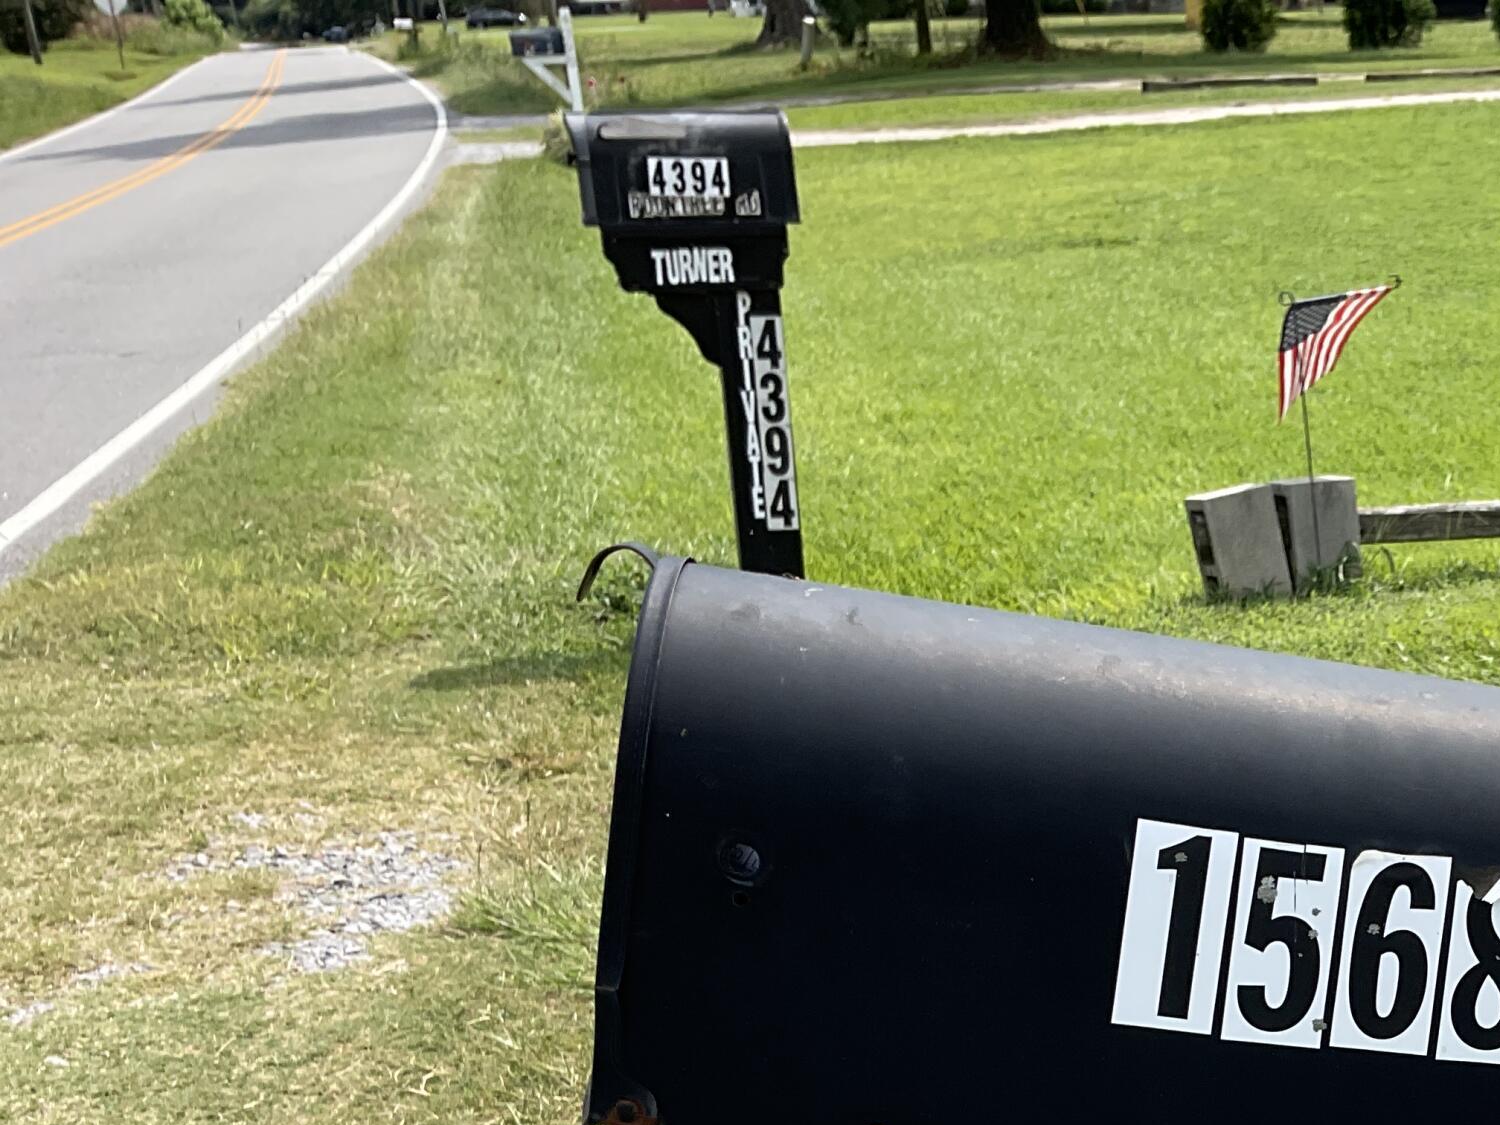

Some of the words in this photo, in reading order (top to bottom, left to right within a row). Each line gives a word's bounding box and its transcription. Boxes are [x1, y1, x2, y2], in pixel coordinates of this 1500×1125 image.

[652, 160, 728, 195] 4394
[650, 247, 735, 286] TURNER
[735, 290, 767, 519] PRIVATE
[757, 319, 796, 528] 4394
